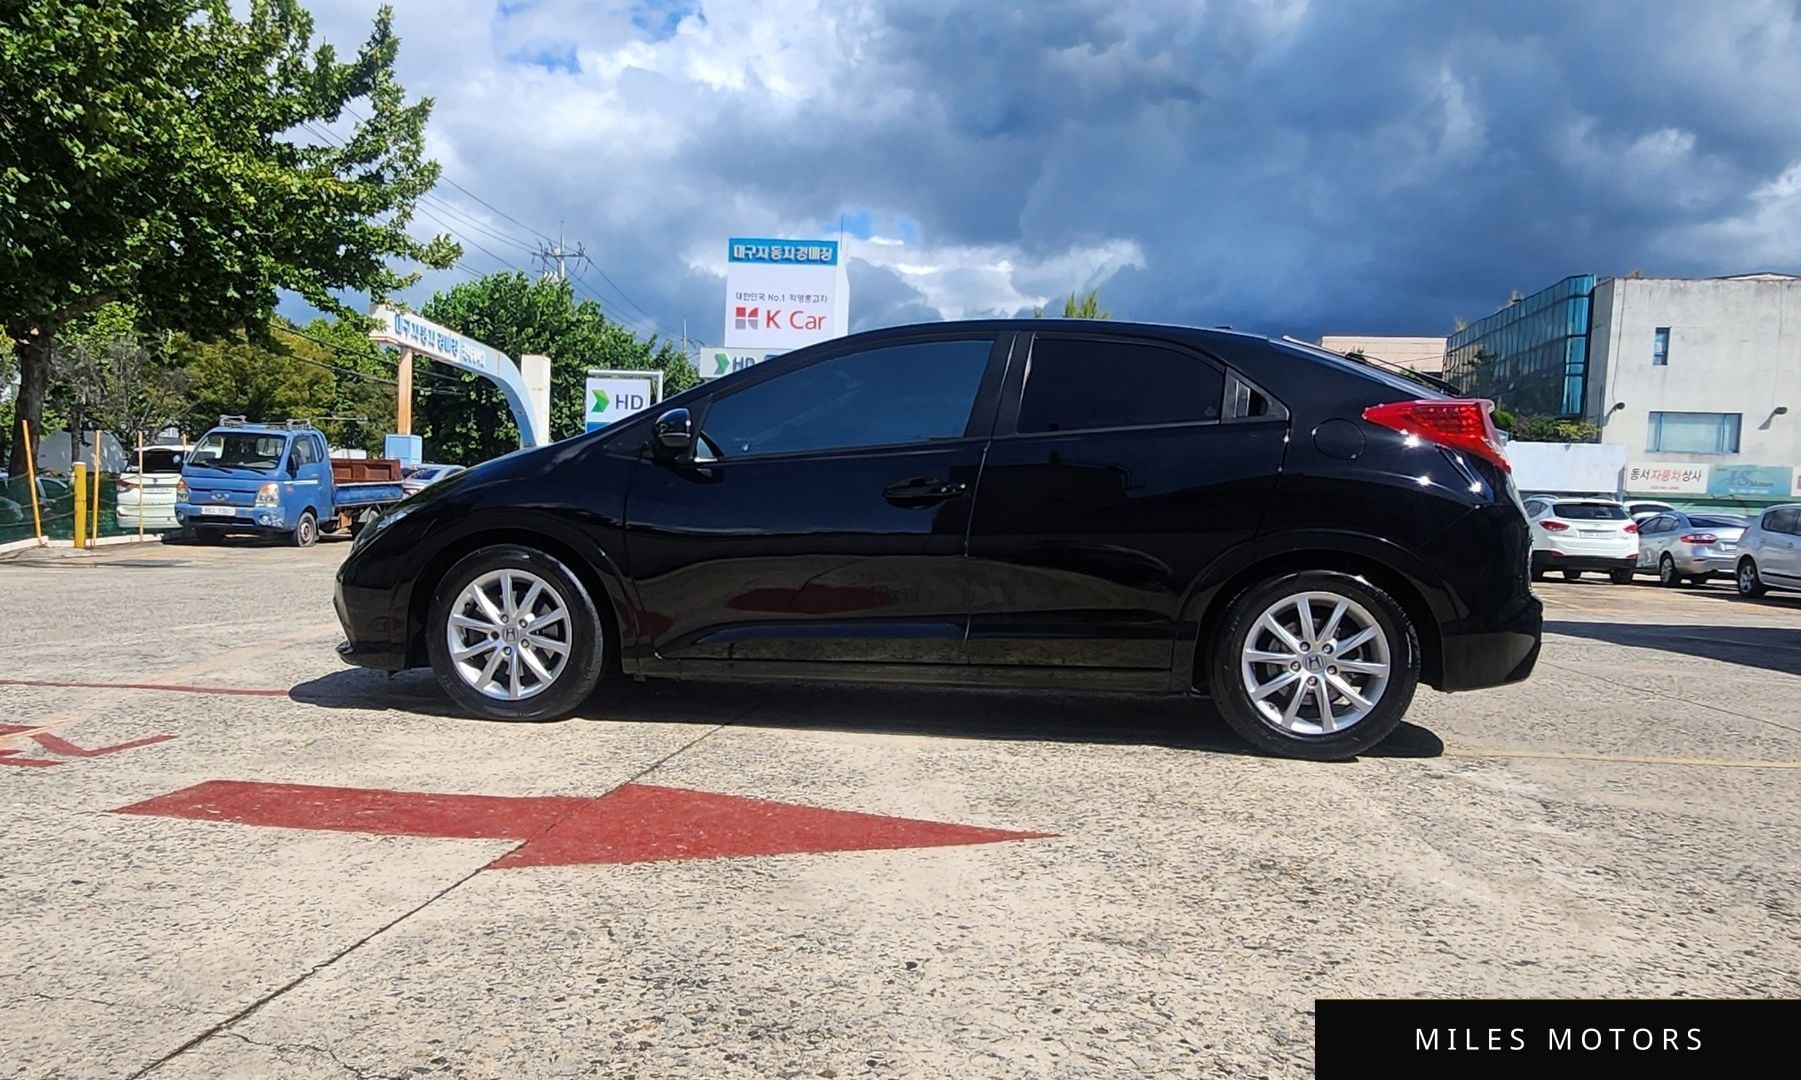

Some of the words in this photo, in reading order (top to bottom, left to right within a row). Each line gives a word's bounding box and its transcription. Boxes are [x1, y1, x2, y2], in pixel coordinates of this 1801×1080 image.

[768, 294, 785, 302] No.1
[766, 310, 781, 329] K
[790, 310, 826, 330] Car
[615, 394, 643, 410] HD
